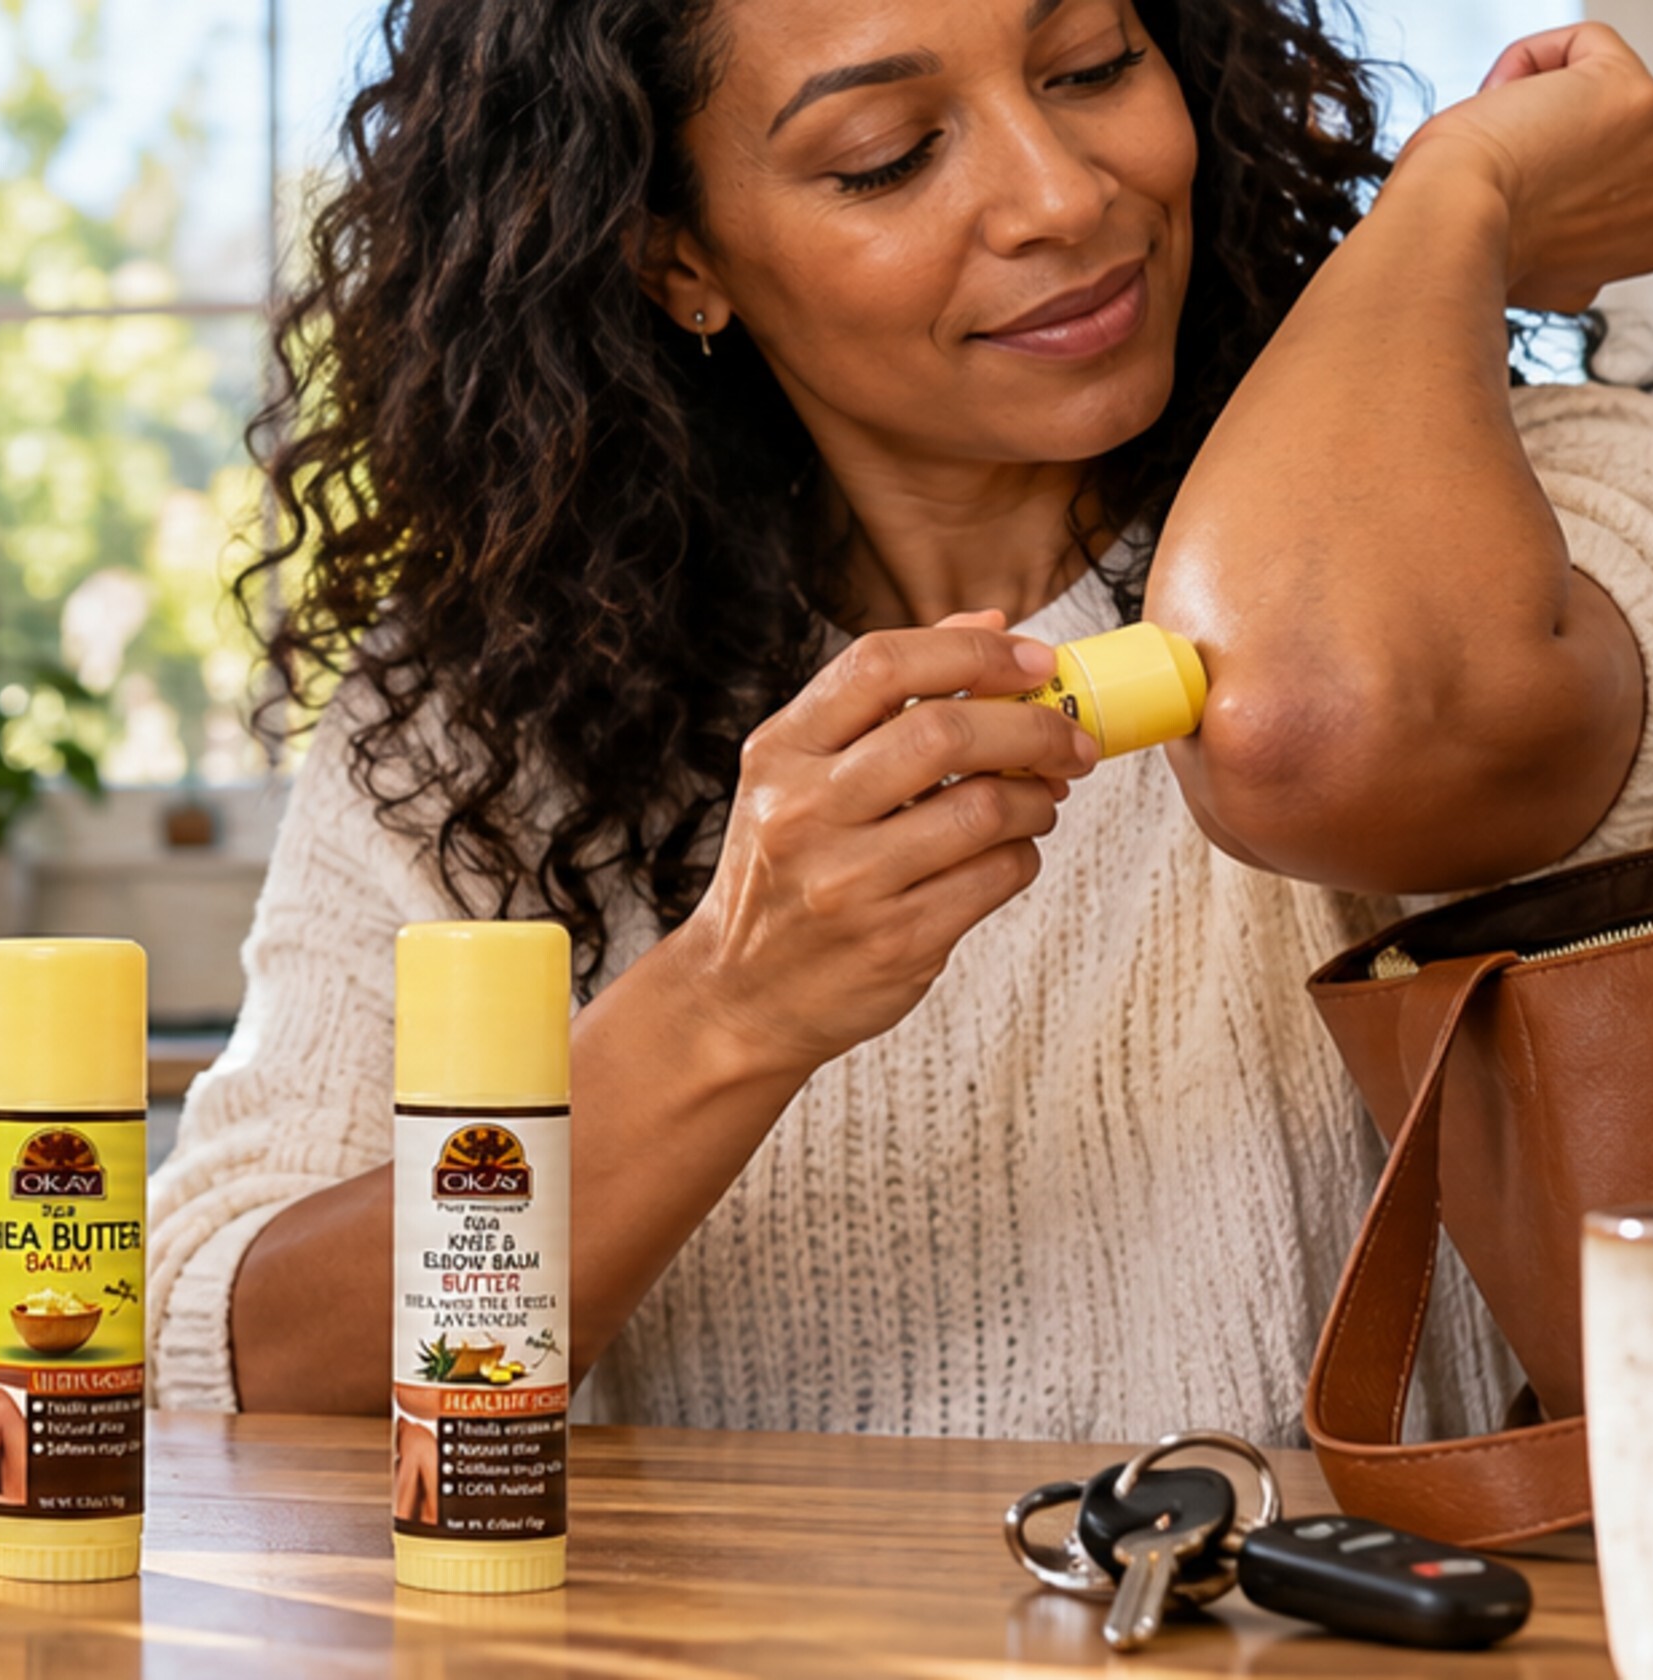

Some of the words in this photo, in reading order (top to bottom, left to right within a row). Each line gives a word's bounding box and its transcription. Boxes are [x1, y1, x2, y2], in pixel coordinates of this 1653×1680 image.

[21, 1172, 98, 1193] OKAY
[52, 1220, 140, 1251] BUTTER
[25, 1251, 92, 1273] BALM
